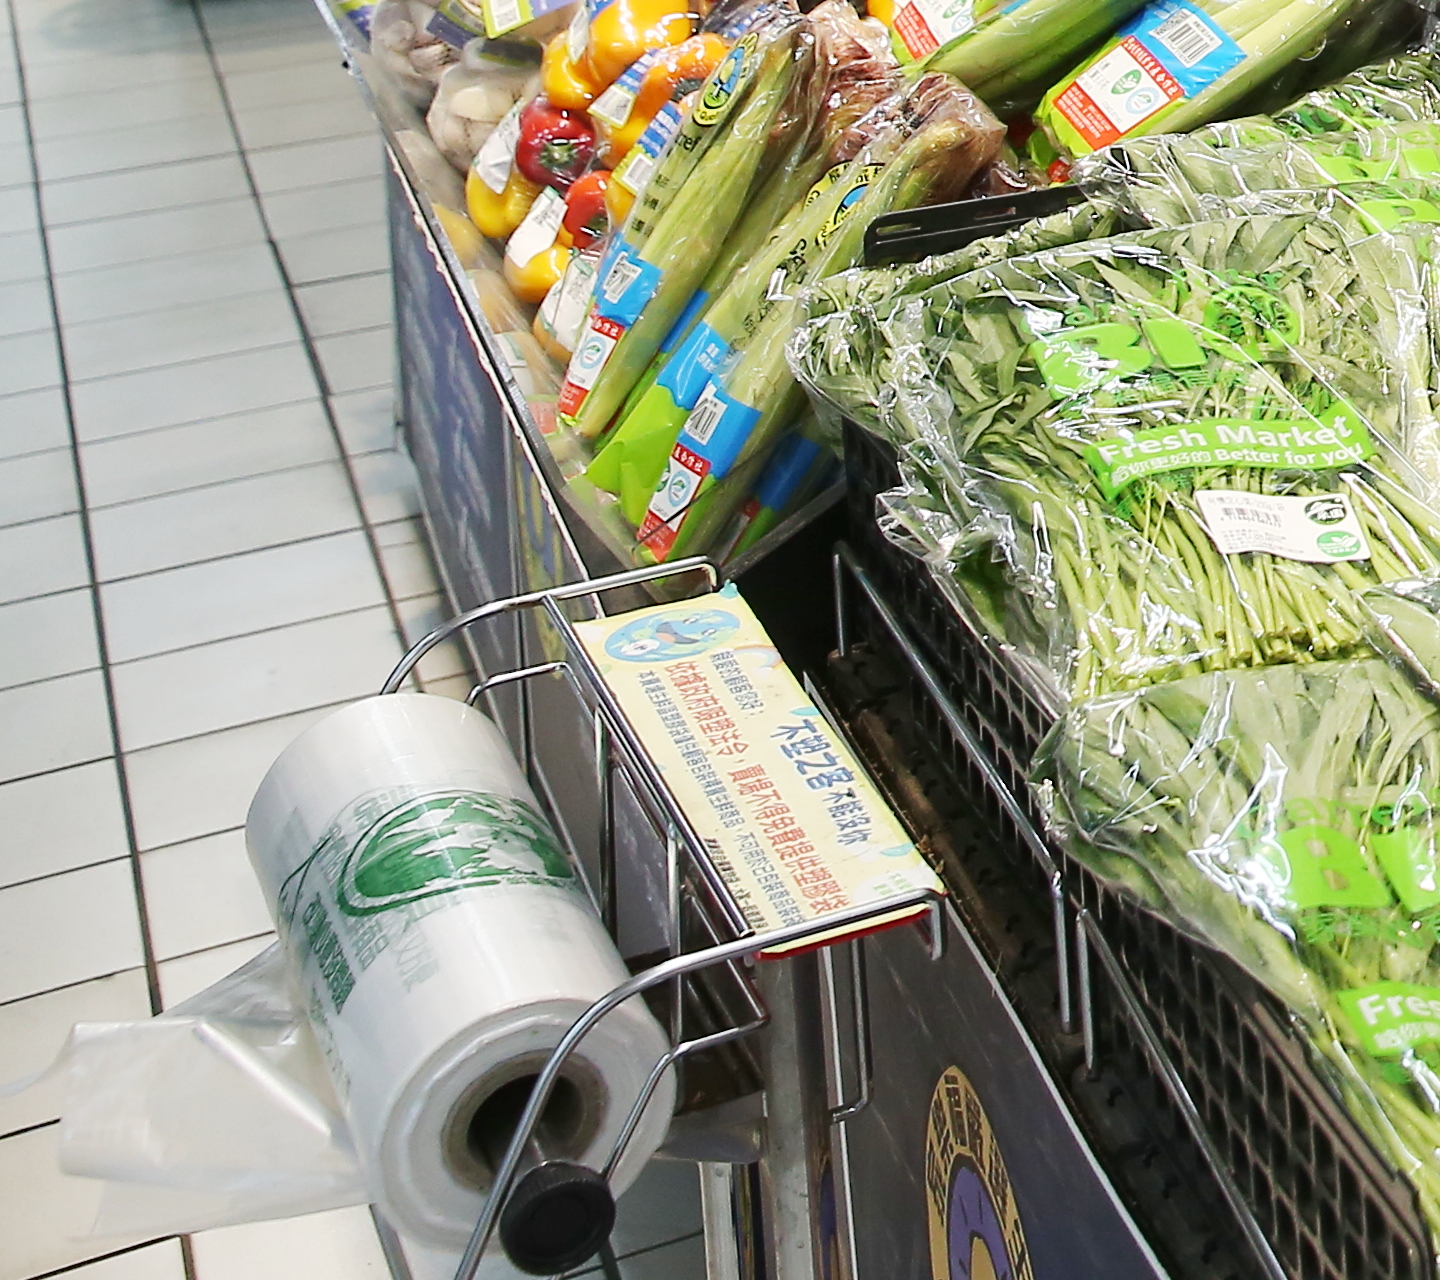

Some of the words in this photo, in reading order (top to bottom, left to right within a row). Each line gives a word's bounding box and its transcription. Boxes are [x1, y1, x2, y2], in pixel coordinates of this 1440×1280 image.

[1098, 427, 1207, 466] Fresh
[1214, 414, 1354, 449] Market
[1214, 448, 1281, 467] Better
[1284, 451, 1318, 468] for
[769, 716, 856, 791] 不塑之客
